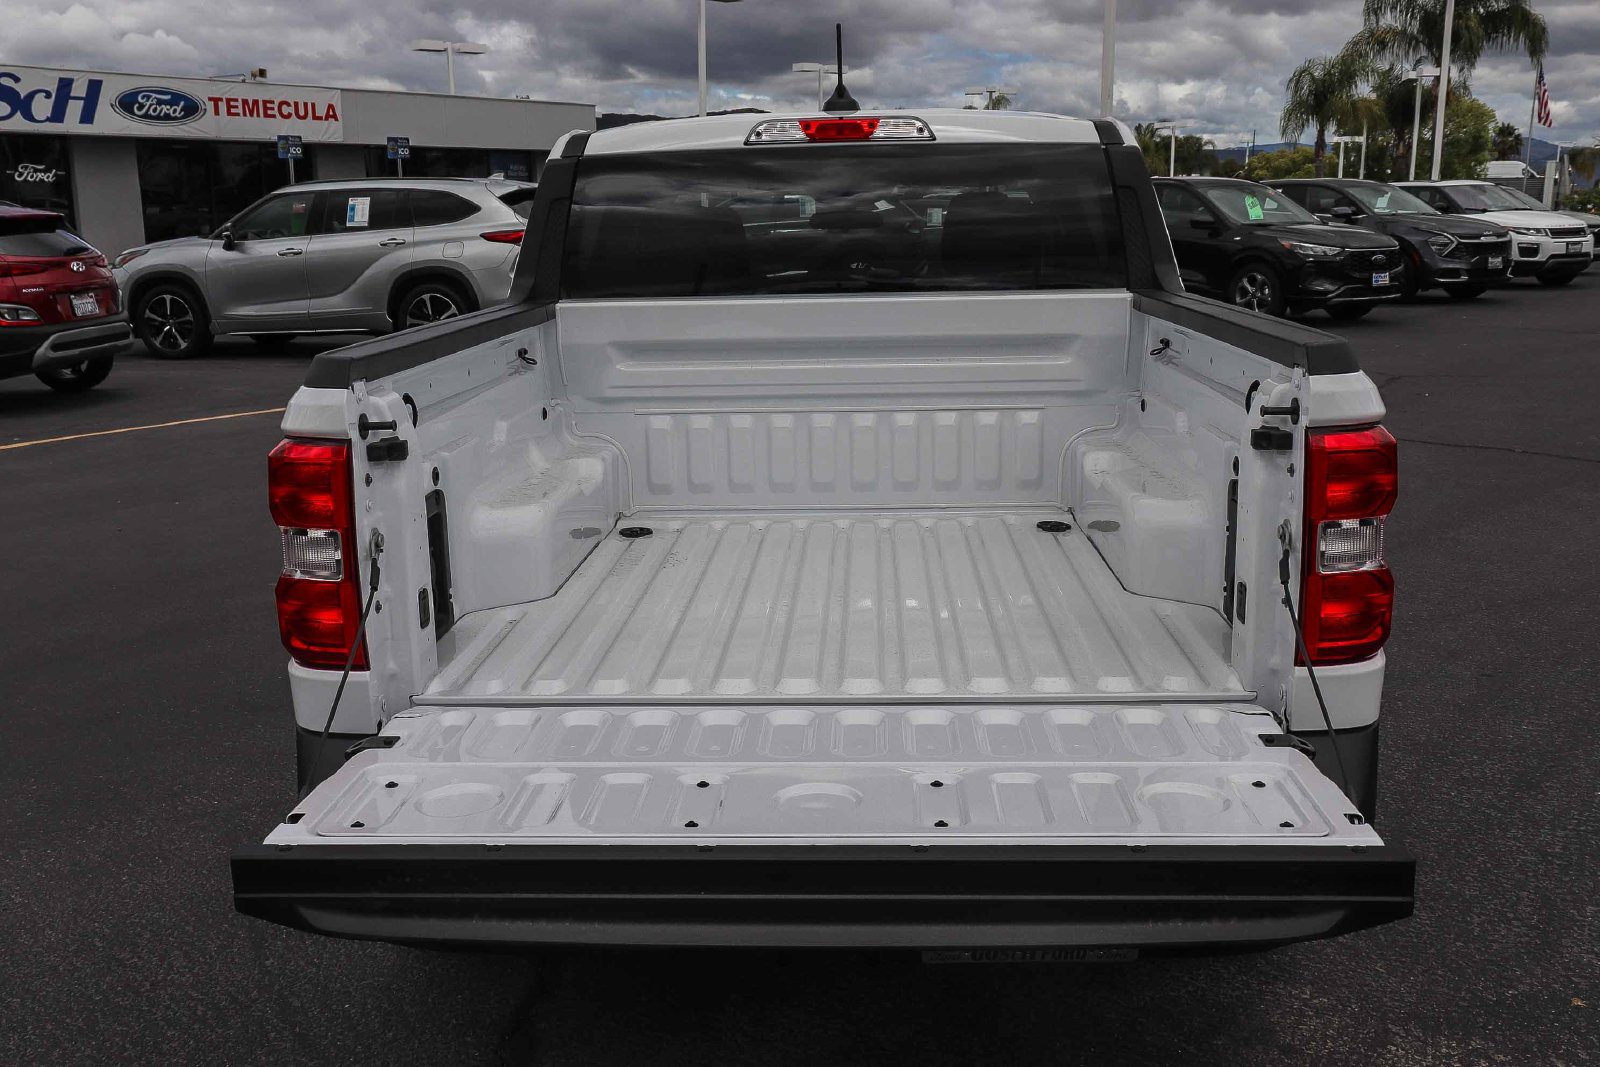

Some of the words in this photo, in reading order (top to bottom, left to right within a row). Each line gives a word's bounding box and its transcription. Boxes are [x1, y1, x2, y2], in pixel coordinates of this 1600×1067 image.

[133, 92, 185, 117] Ford
[208, 96, 340, 122] TEMECULA
[14, 163, 56, 182] Ford
